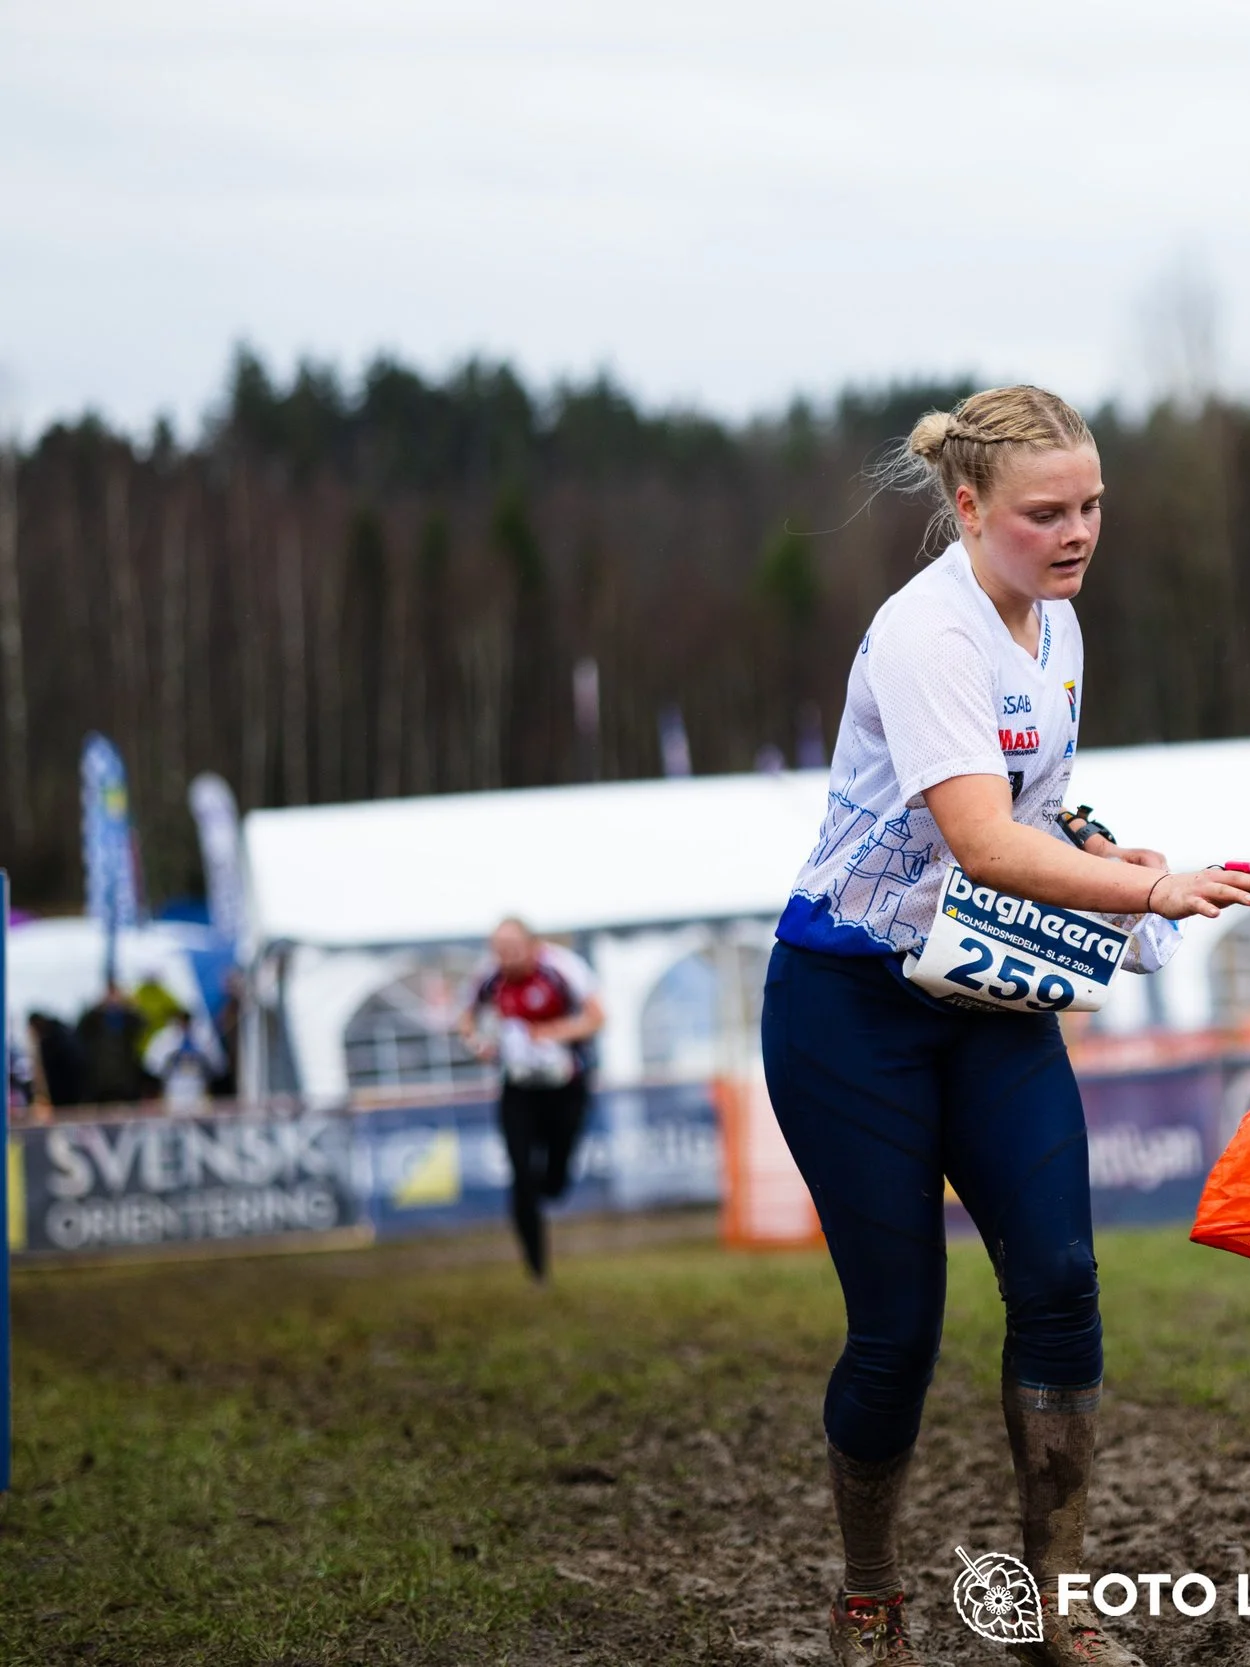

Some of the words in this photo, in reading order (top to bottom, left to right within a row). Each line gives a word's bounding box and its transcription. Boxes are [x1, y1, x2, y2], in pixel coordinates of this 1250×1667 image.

[947, 869, 1123, 963] bagheera
[957, 910, 1040, 953] KOLMÅRDSMEDELN
[1046, 950, 1056, 961] SL
[1057, 954, 1071, 966] #2
[1072, 960, 1095, 976] 2026
[944, 937, 1075, 1011] 259
